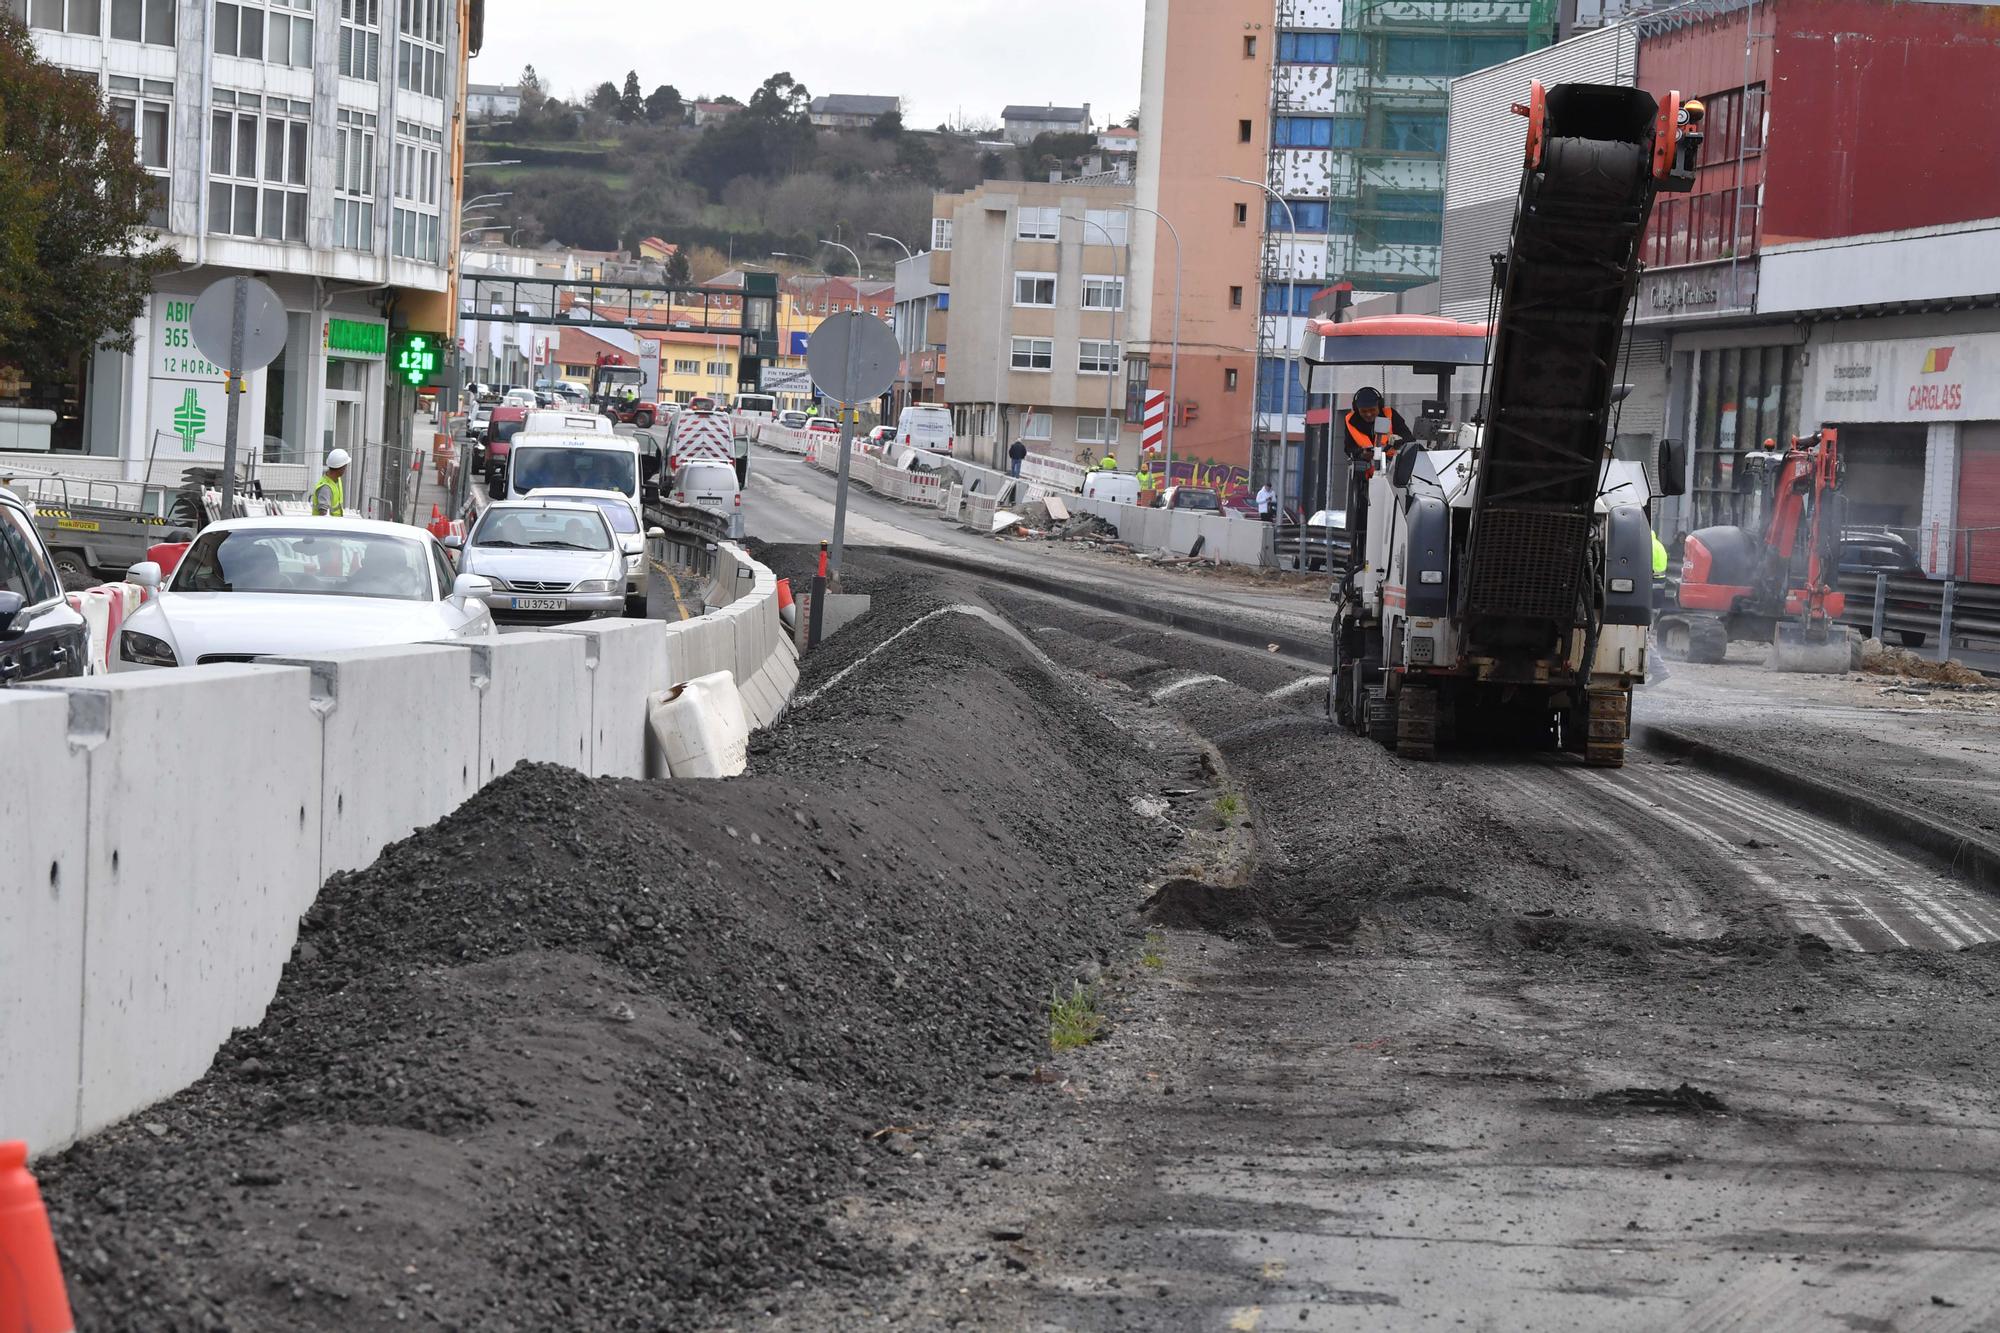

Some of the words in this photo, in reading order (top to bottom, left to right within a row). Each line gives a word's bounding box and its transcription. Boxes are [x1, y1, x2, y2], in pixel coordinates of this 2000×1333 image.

[165, 327, 189, 347] 365
[164, 358, 176, 372] 12
[399, 351, 433, 370] 12H
[1908, 384, 1962, 411] CARGLASS
[518, 599, 530, 609] LU
[532, 600, 555, 610] 3752
[557, 600, 563, 609] V
